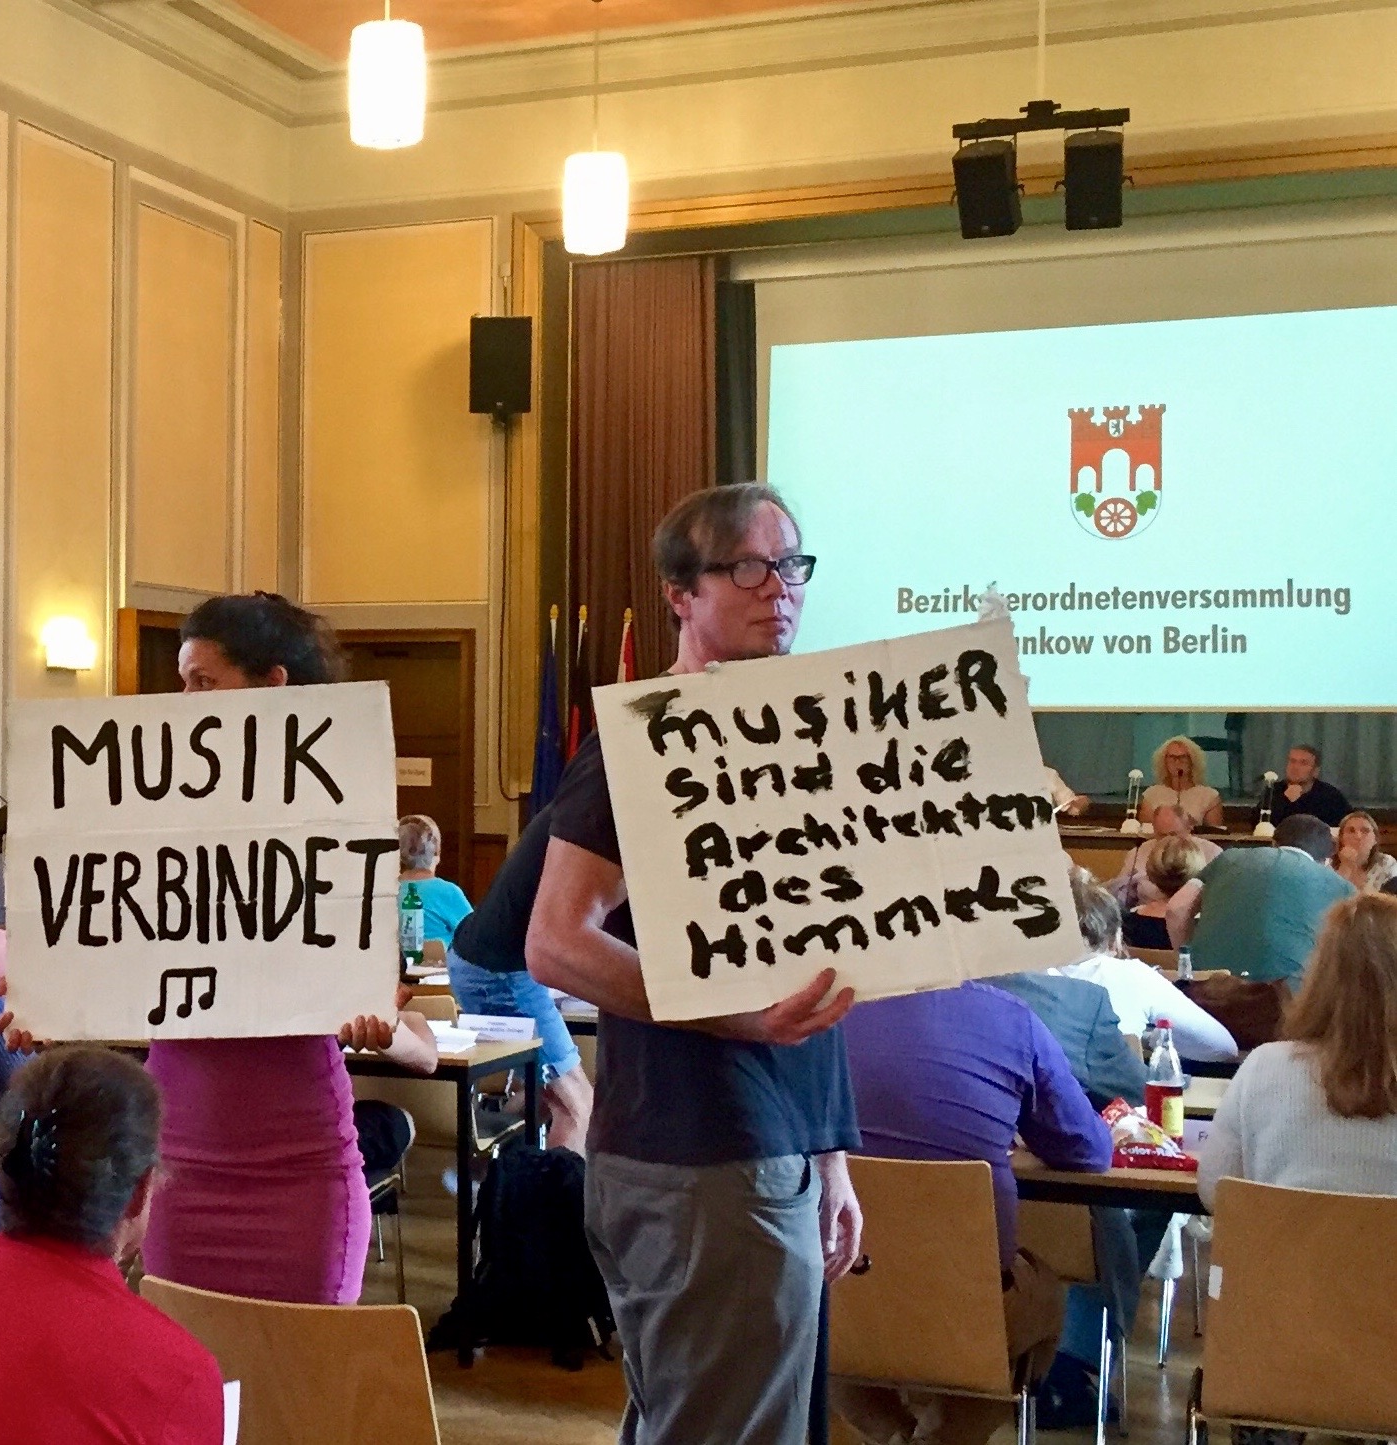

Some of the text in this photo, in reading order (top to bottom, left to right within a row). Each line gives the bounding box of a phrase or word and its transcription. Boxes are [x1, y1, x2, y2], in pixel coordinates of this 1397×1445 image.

[897, 578, 1351, 615] Bezirkerordnetenversammlung
[1103, 634, 1152, 654] von
[1163, 623, 1248, 655] Berlin
[51, 713, 344, 809] MUSIK
[664, 736, 973, 819] sind die
[683, 791, 1054, 880] Architekten
[33, 836, 400, 949] VERBINDET
[718, 864, 865, 914] des
